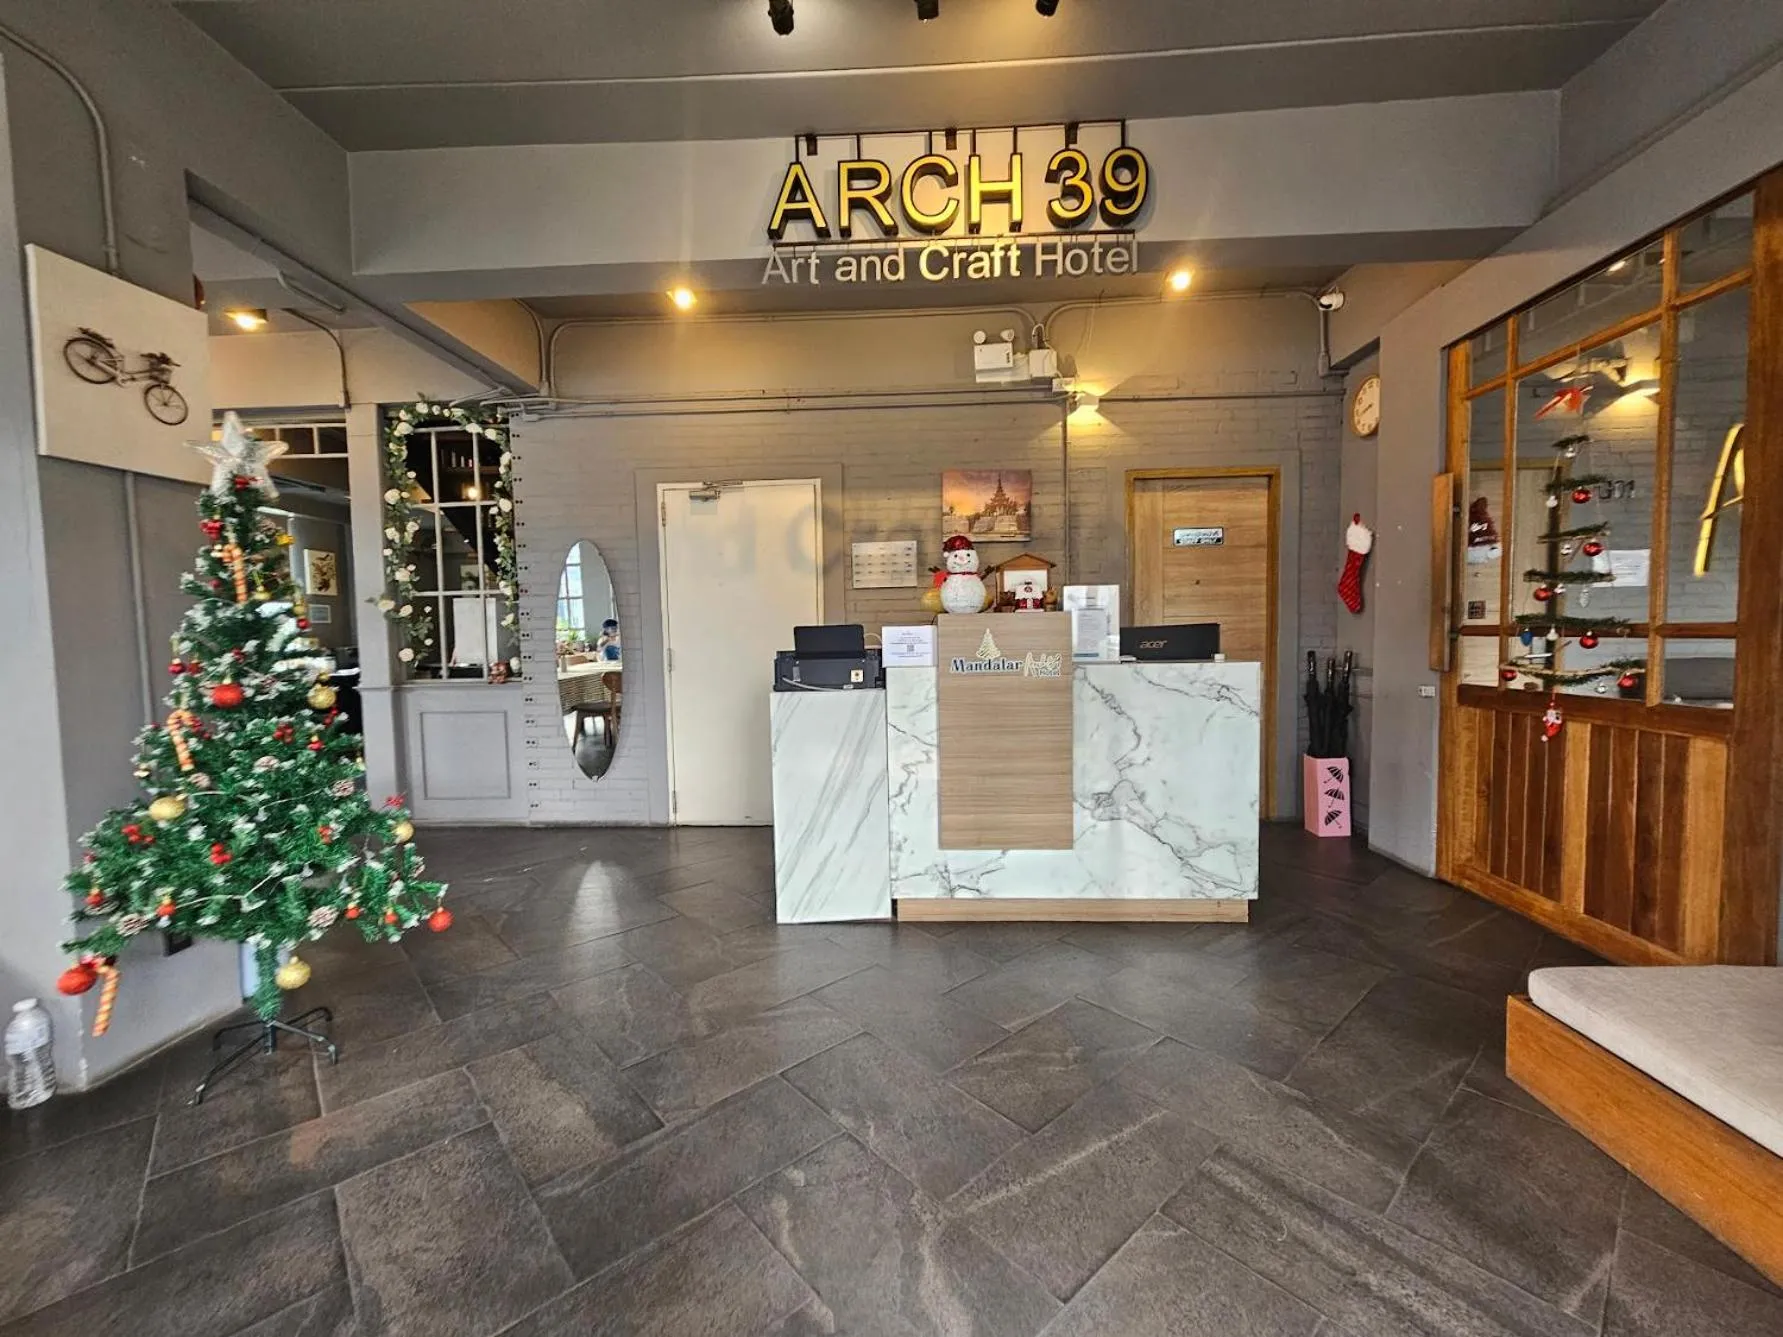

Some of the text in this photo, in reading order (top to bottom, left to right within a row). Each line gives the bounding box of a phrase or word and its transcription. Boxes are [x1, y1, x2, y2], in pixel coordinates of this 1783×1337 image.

[767, 146, 1150, 239] ARCH 39
[761, 239, 1138, 285] Art and Craft Hotel
[1139, 639, 1168, 649] acer
[952, 658, 1022, 673] Mandalar
